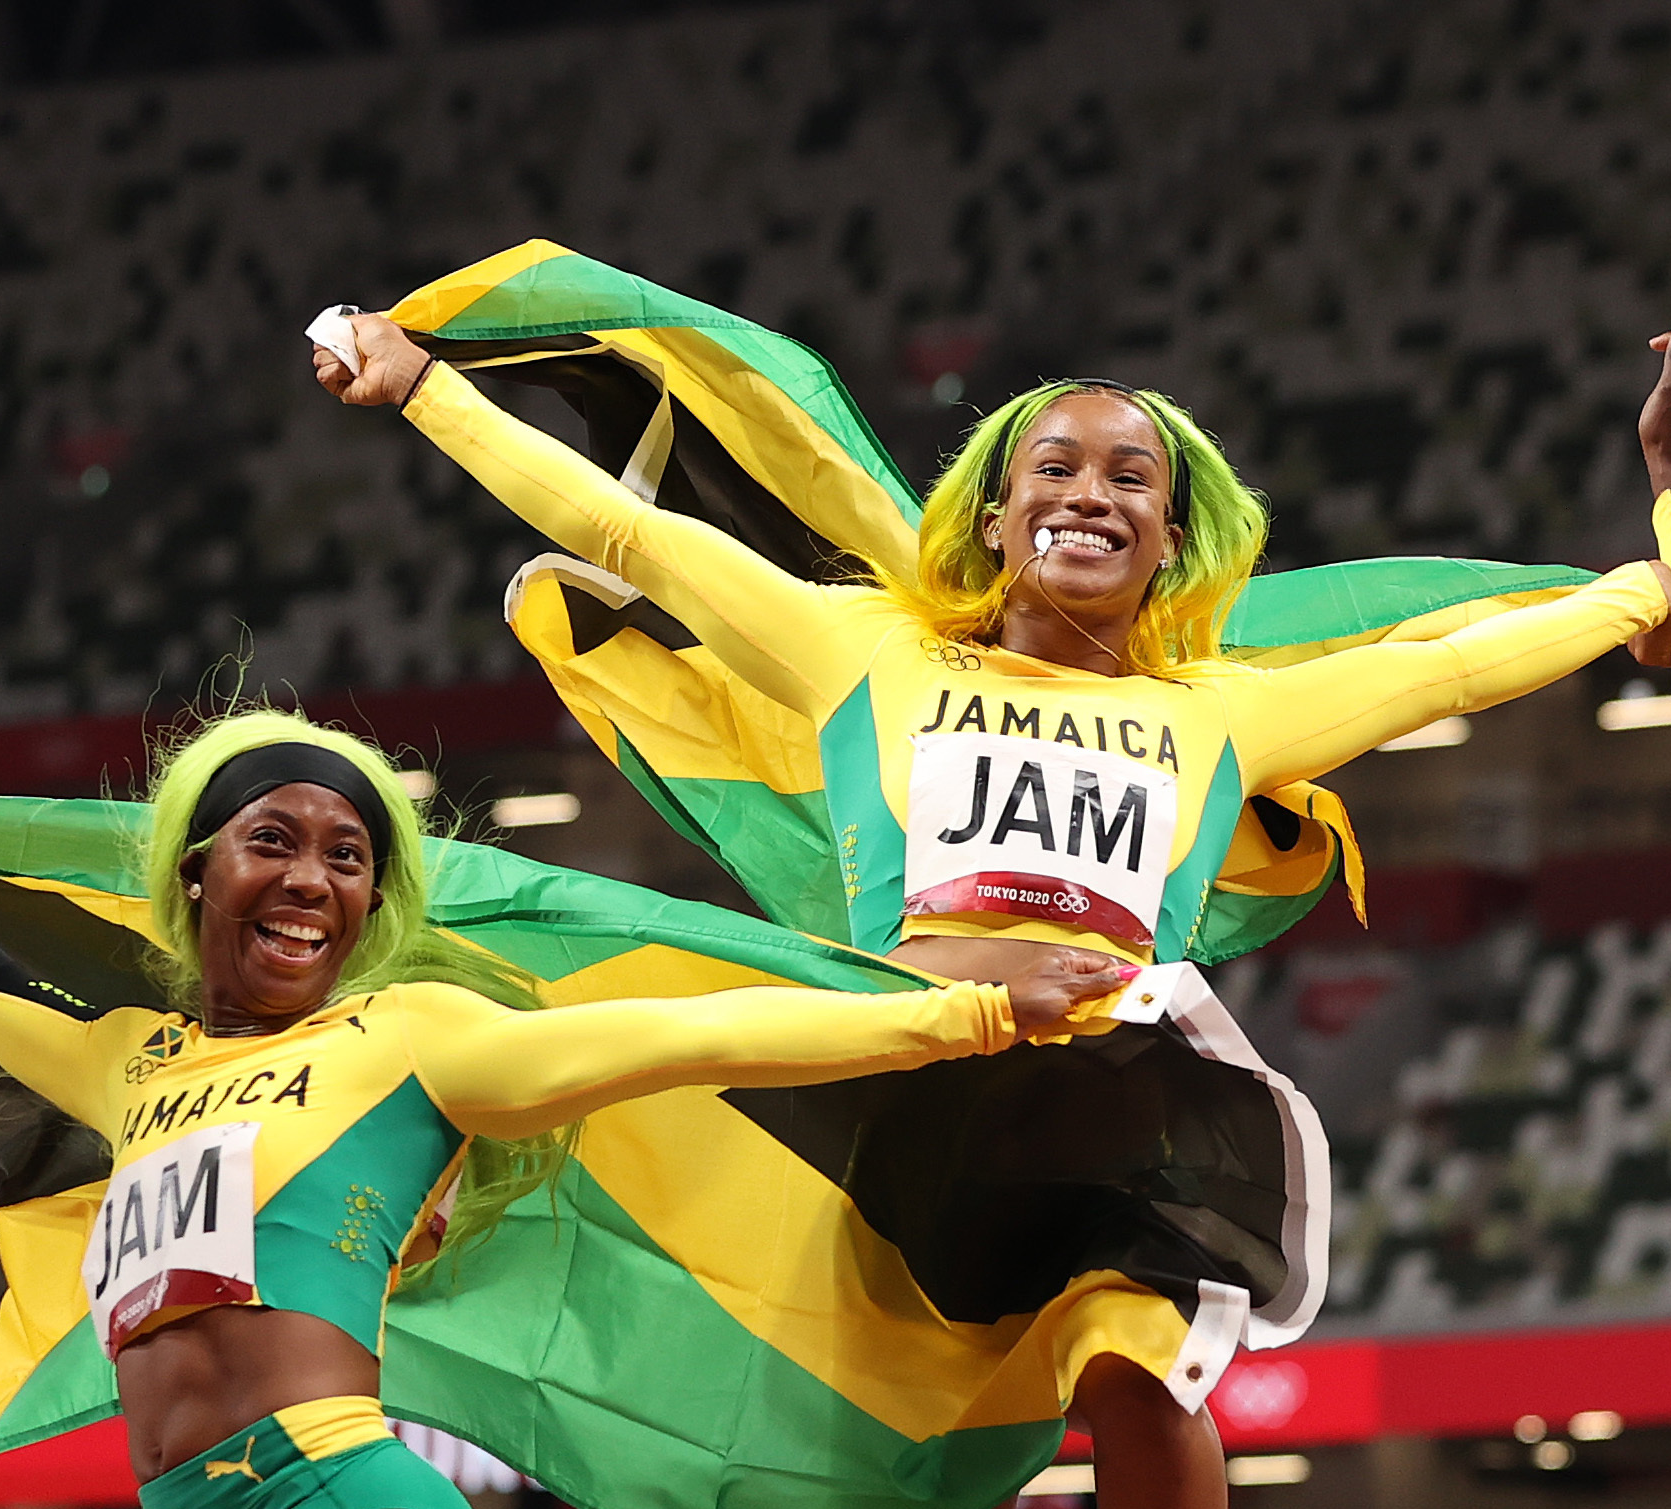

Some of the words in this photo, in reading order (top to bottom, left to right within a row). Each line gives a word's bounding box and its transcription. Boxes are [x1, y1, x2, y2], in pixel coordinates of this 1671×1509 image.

[919, 689, 1179, 775] JAMAICA
[937, 755, 1148, 873] JAM
[976, 885, 1018, 901] TOKYO
[1018, 889, 1050, 905] 2020
[95, 1145, 222, 1300] JAM
